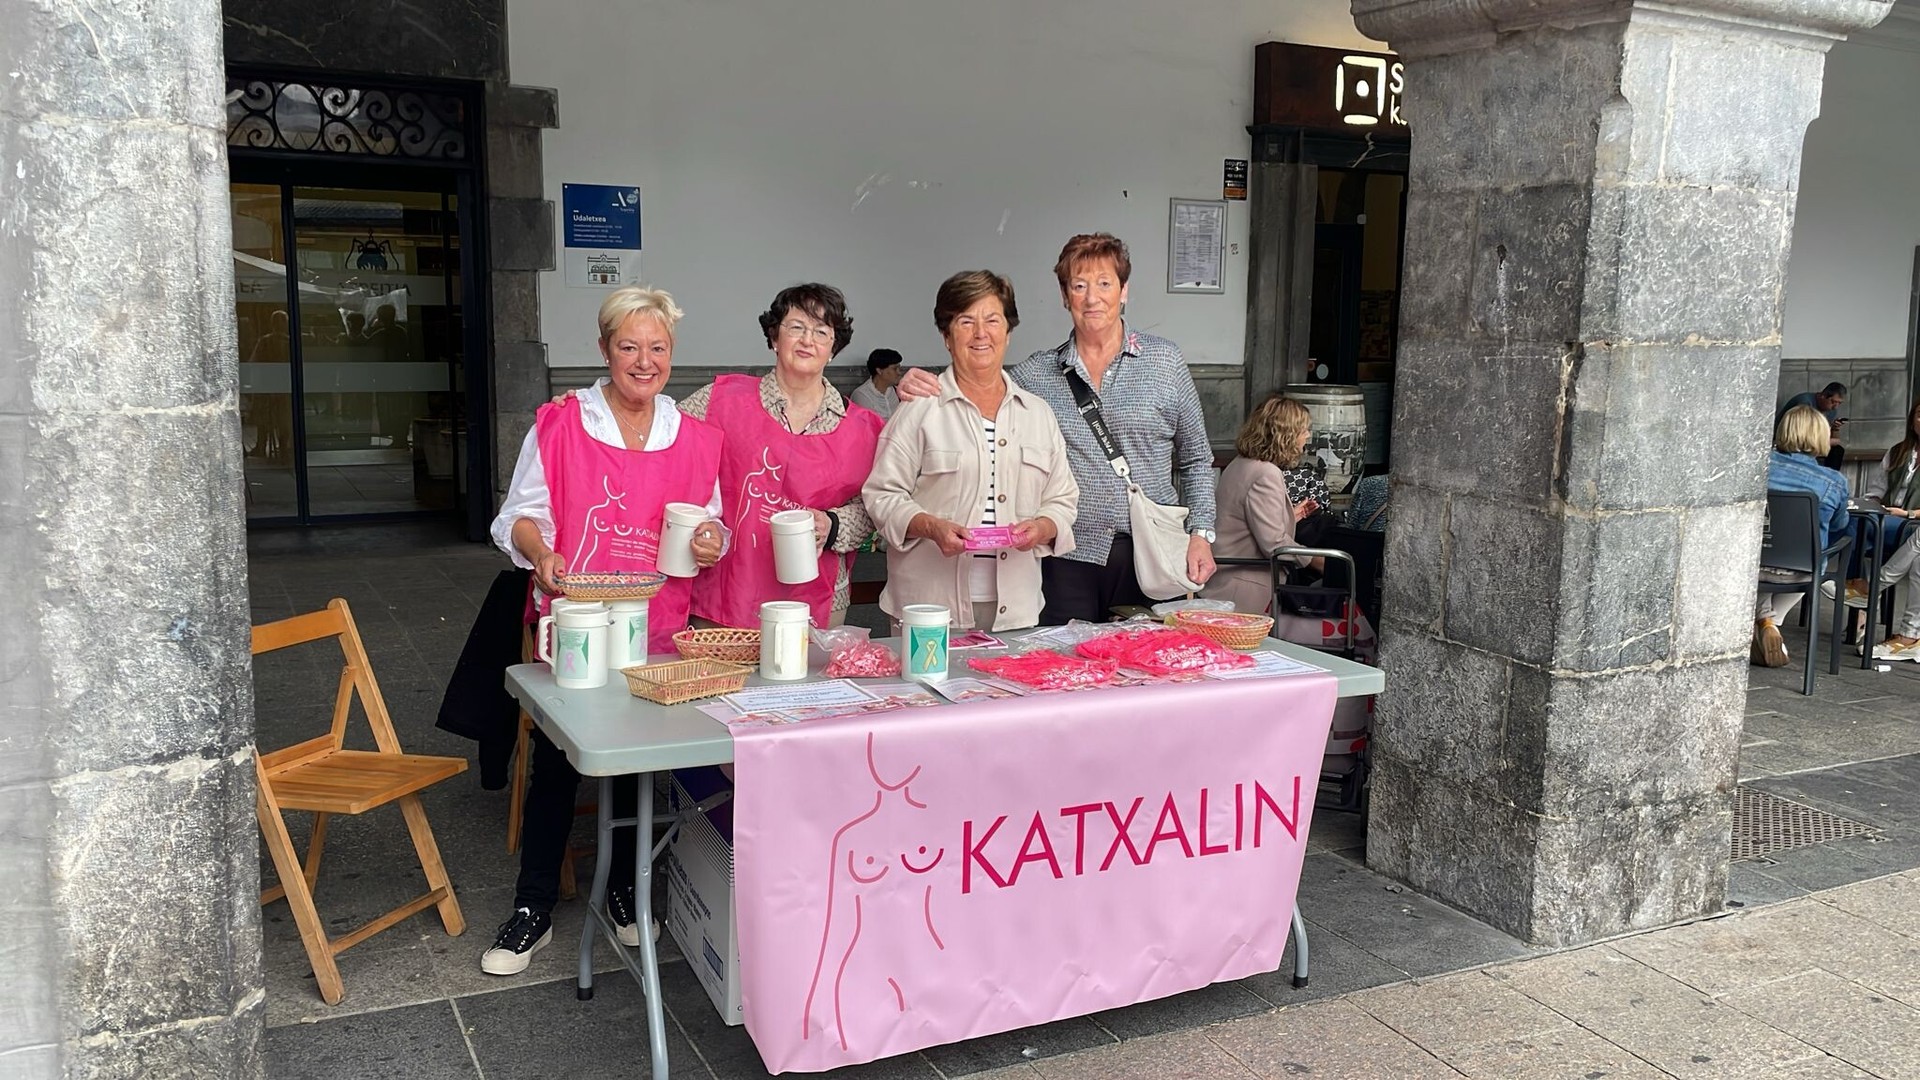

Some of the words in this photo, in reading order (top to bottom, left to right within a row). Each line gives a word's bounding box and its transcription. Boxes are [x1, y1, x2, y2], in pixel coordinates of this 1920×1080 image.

[1389, 62, 1404, 94] S
[573, 214, 607, 223] Udaletxea
[782, 498, 807, 511] KATXA
[961, 776, 1301, 894] KATXALIN
